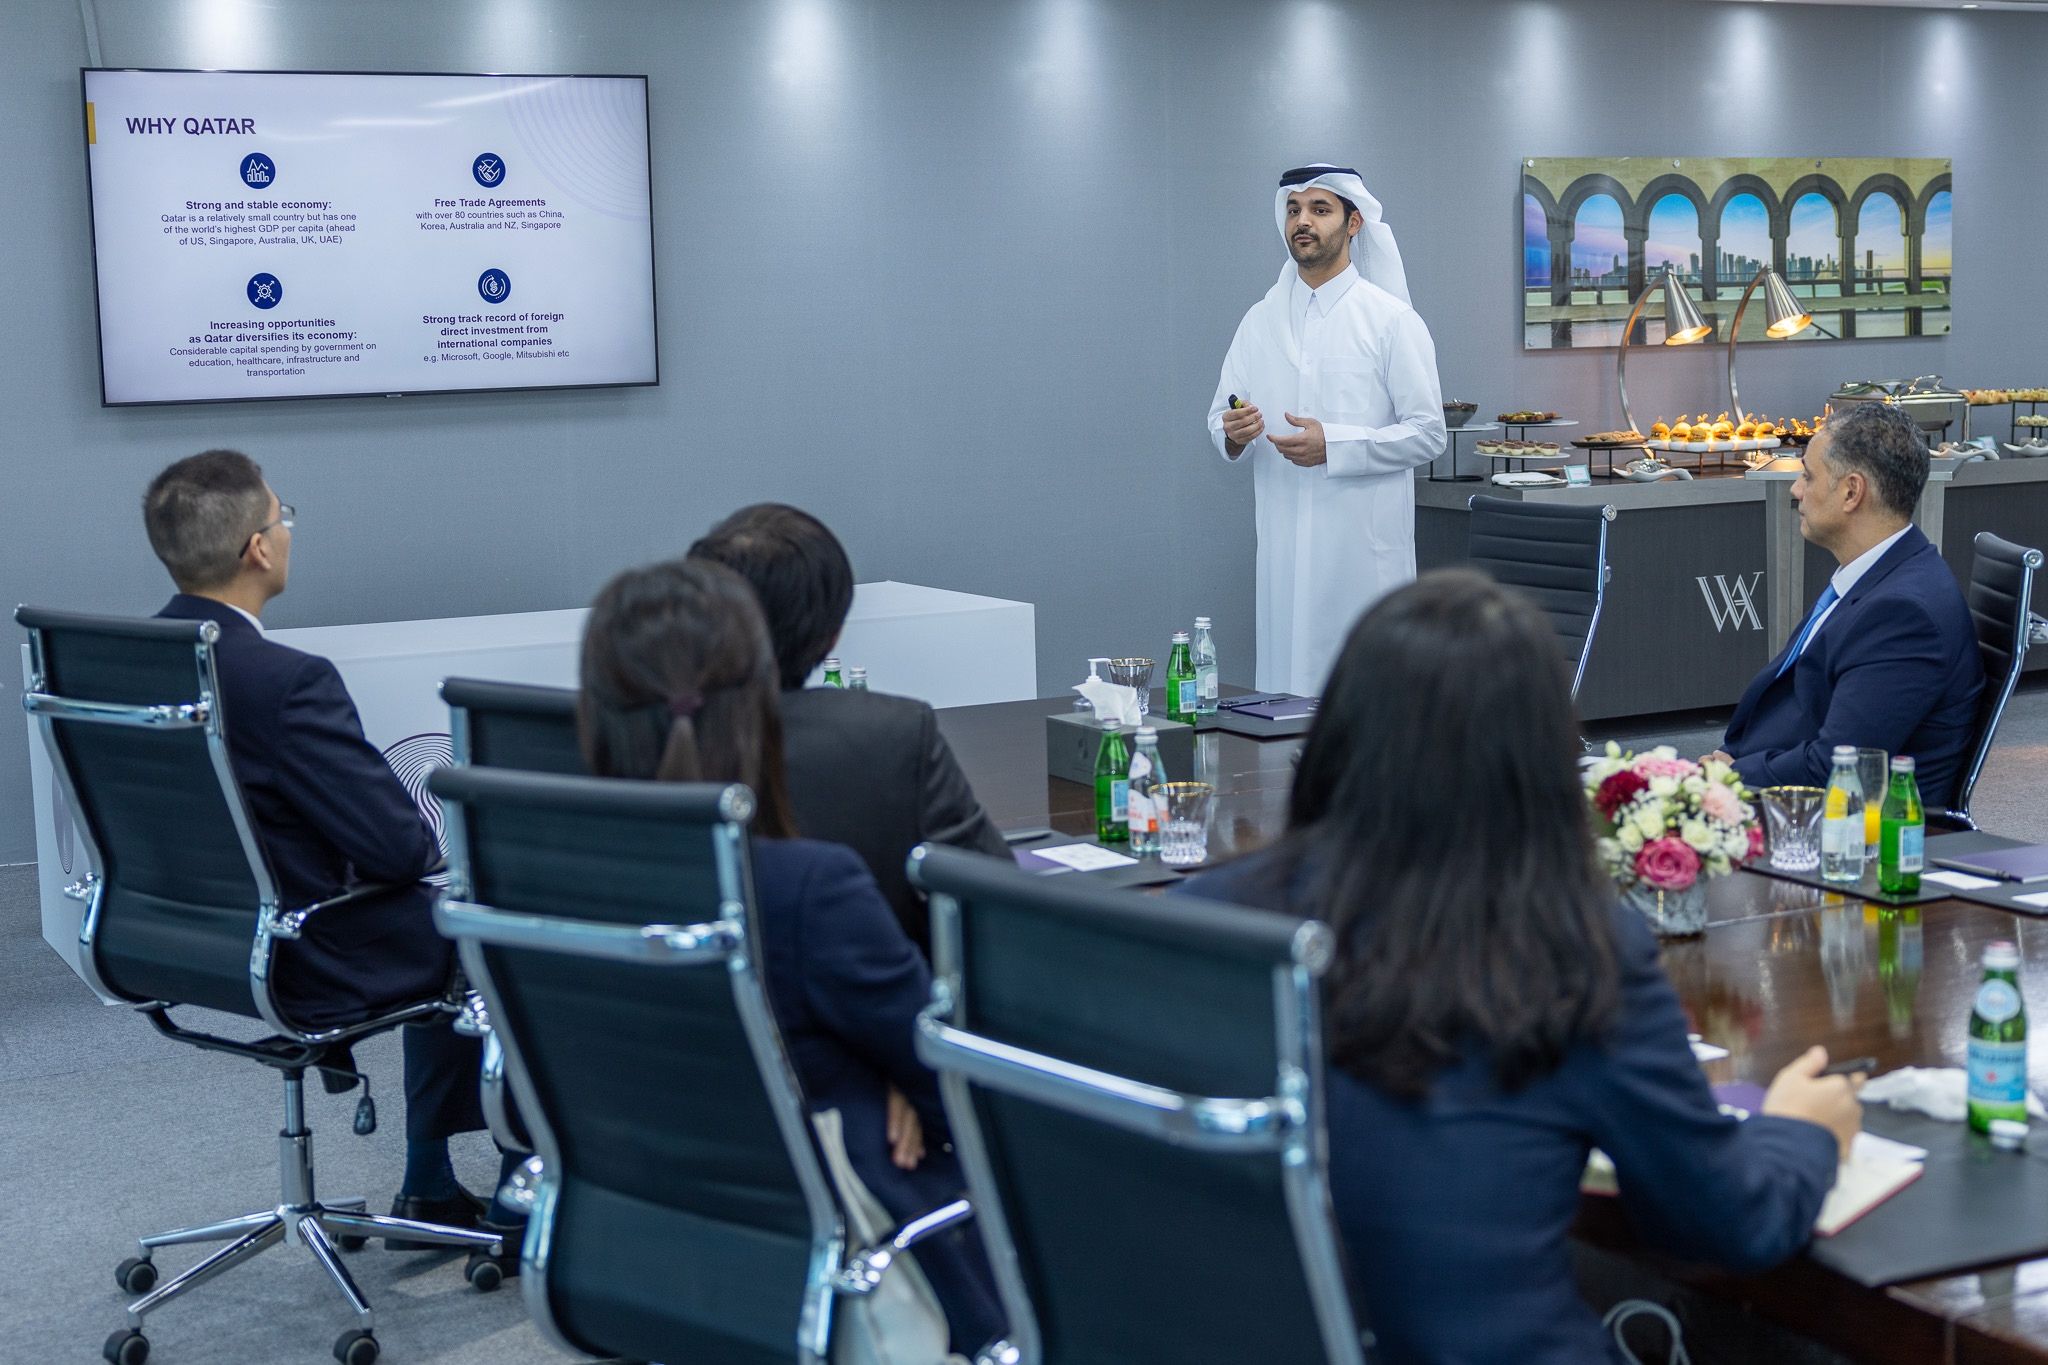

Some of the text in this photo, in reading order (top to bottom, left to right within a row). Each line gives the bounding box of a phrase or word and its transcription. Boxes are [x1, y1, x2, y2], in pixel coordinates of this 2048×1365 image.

[126, 118, 256, 135] WHY QATAR
[186, 201, 332, 211] Strong and stable economy:
[488, 198, 546, 208] Agreements
[189, 214, 195, 222] is
[207, 214, 245, 223] relatively
[273, 214, 304, 223] country
[539, 211, 564, 219] China,
[164, 226, 172, 234] of
[192, 225, 222, 233] world's
[225, 225, 256, 234] highest
[259, 225, 279, 233] GDP
[282, 226, 295, 234] per
[298, 224, 324, 234] capita
[327, 224, 355, 233] (ahead
[421, 223, 448, 231] Korea,
[504, 222, 518, 230] NZ,
[521, 222, 561, 230] Singapore
[180, 236, 342, 246] of US, Singapore, Australia, UK, UAE)
[210, 318, 335, 330] Increasing opportunities
[423, 315, 456, 325] Strong
[486, 314, 516, 322] record
[531, 313, 564, 322] foreign
[441, 326, 548, 336] direct investment from
[189, 332, 357, 344] as Qatar diversifies its economy:
[438, 338, 552, 348] international companies
[170, 347, 227, 356] Considerable
[230, 345, 258, 355] capital
[260, 344, 299, 354] spending
[302, 344, 311, 353] by
[314, 343, 363, 353] government
[189, 354, 360, 367] education, healthcare, infrastructure and
[424, 355, 438, 363] e.g.
[442, 353, 480, 361] Microsoft,
[483, 352, 513, 361] Google,
[516, 351, 555, 359] Mitsubishi
[247, 368, 305, 377] transportation
